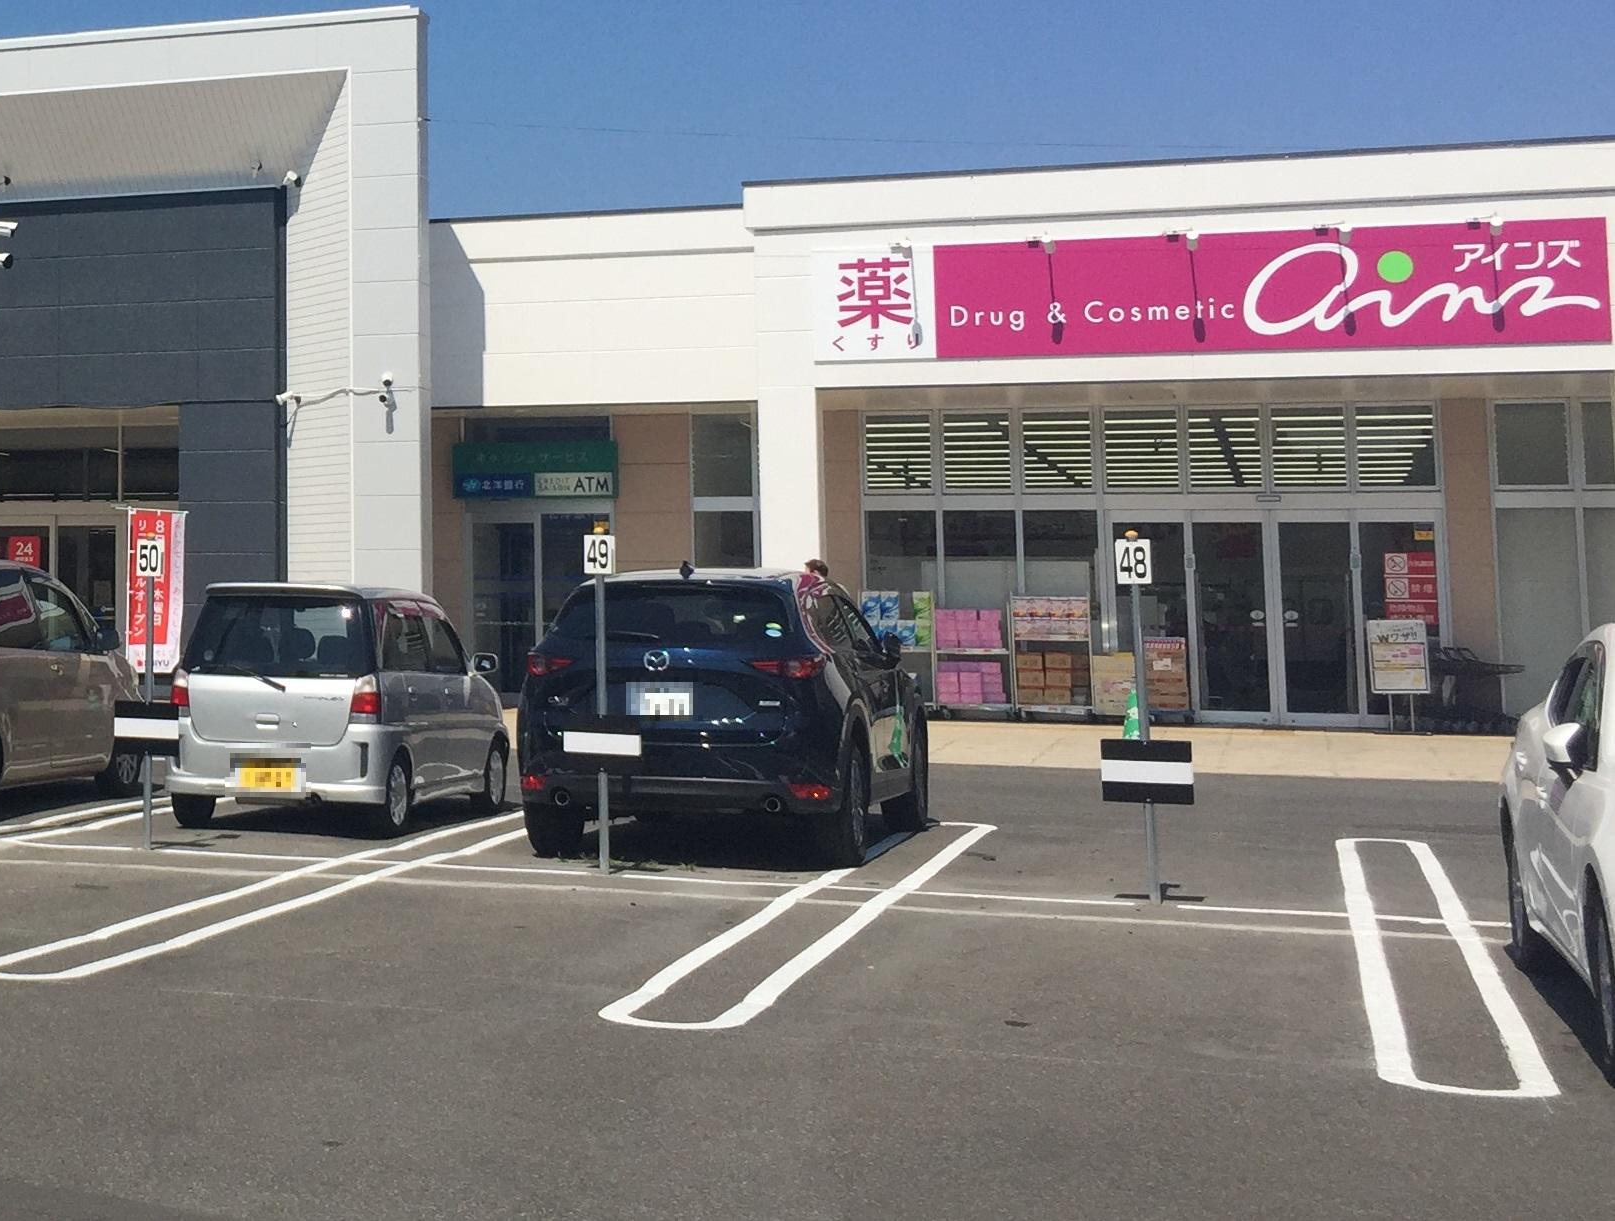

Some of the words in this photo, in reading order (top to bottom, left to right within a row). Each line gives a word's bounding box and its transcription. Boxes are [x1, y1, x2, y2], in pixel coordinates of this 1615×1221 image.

[1453, 239, 1581, 273] アインズ
[837, 257, 915, 329] 薬
[950, 304, 1026, 332] Drug
[1047, 301, 1067, 325] &
[1084, 297, 1236, 324] Cosmetic
[832, 332, 922, 351] くすり
[573, 476, 609, 493] ATM
[15, 541, 34, 556] 24
[139, 544, 159, 572] 50
[587, 539, 609, 569] 49
[1119, 546, 1147, 579] 48
